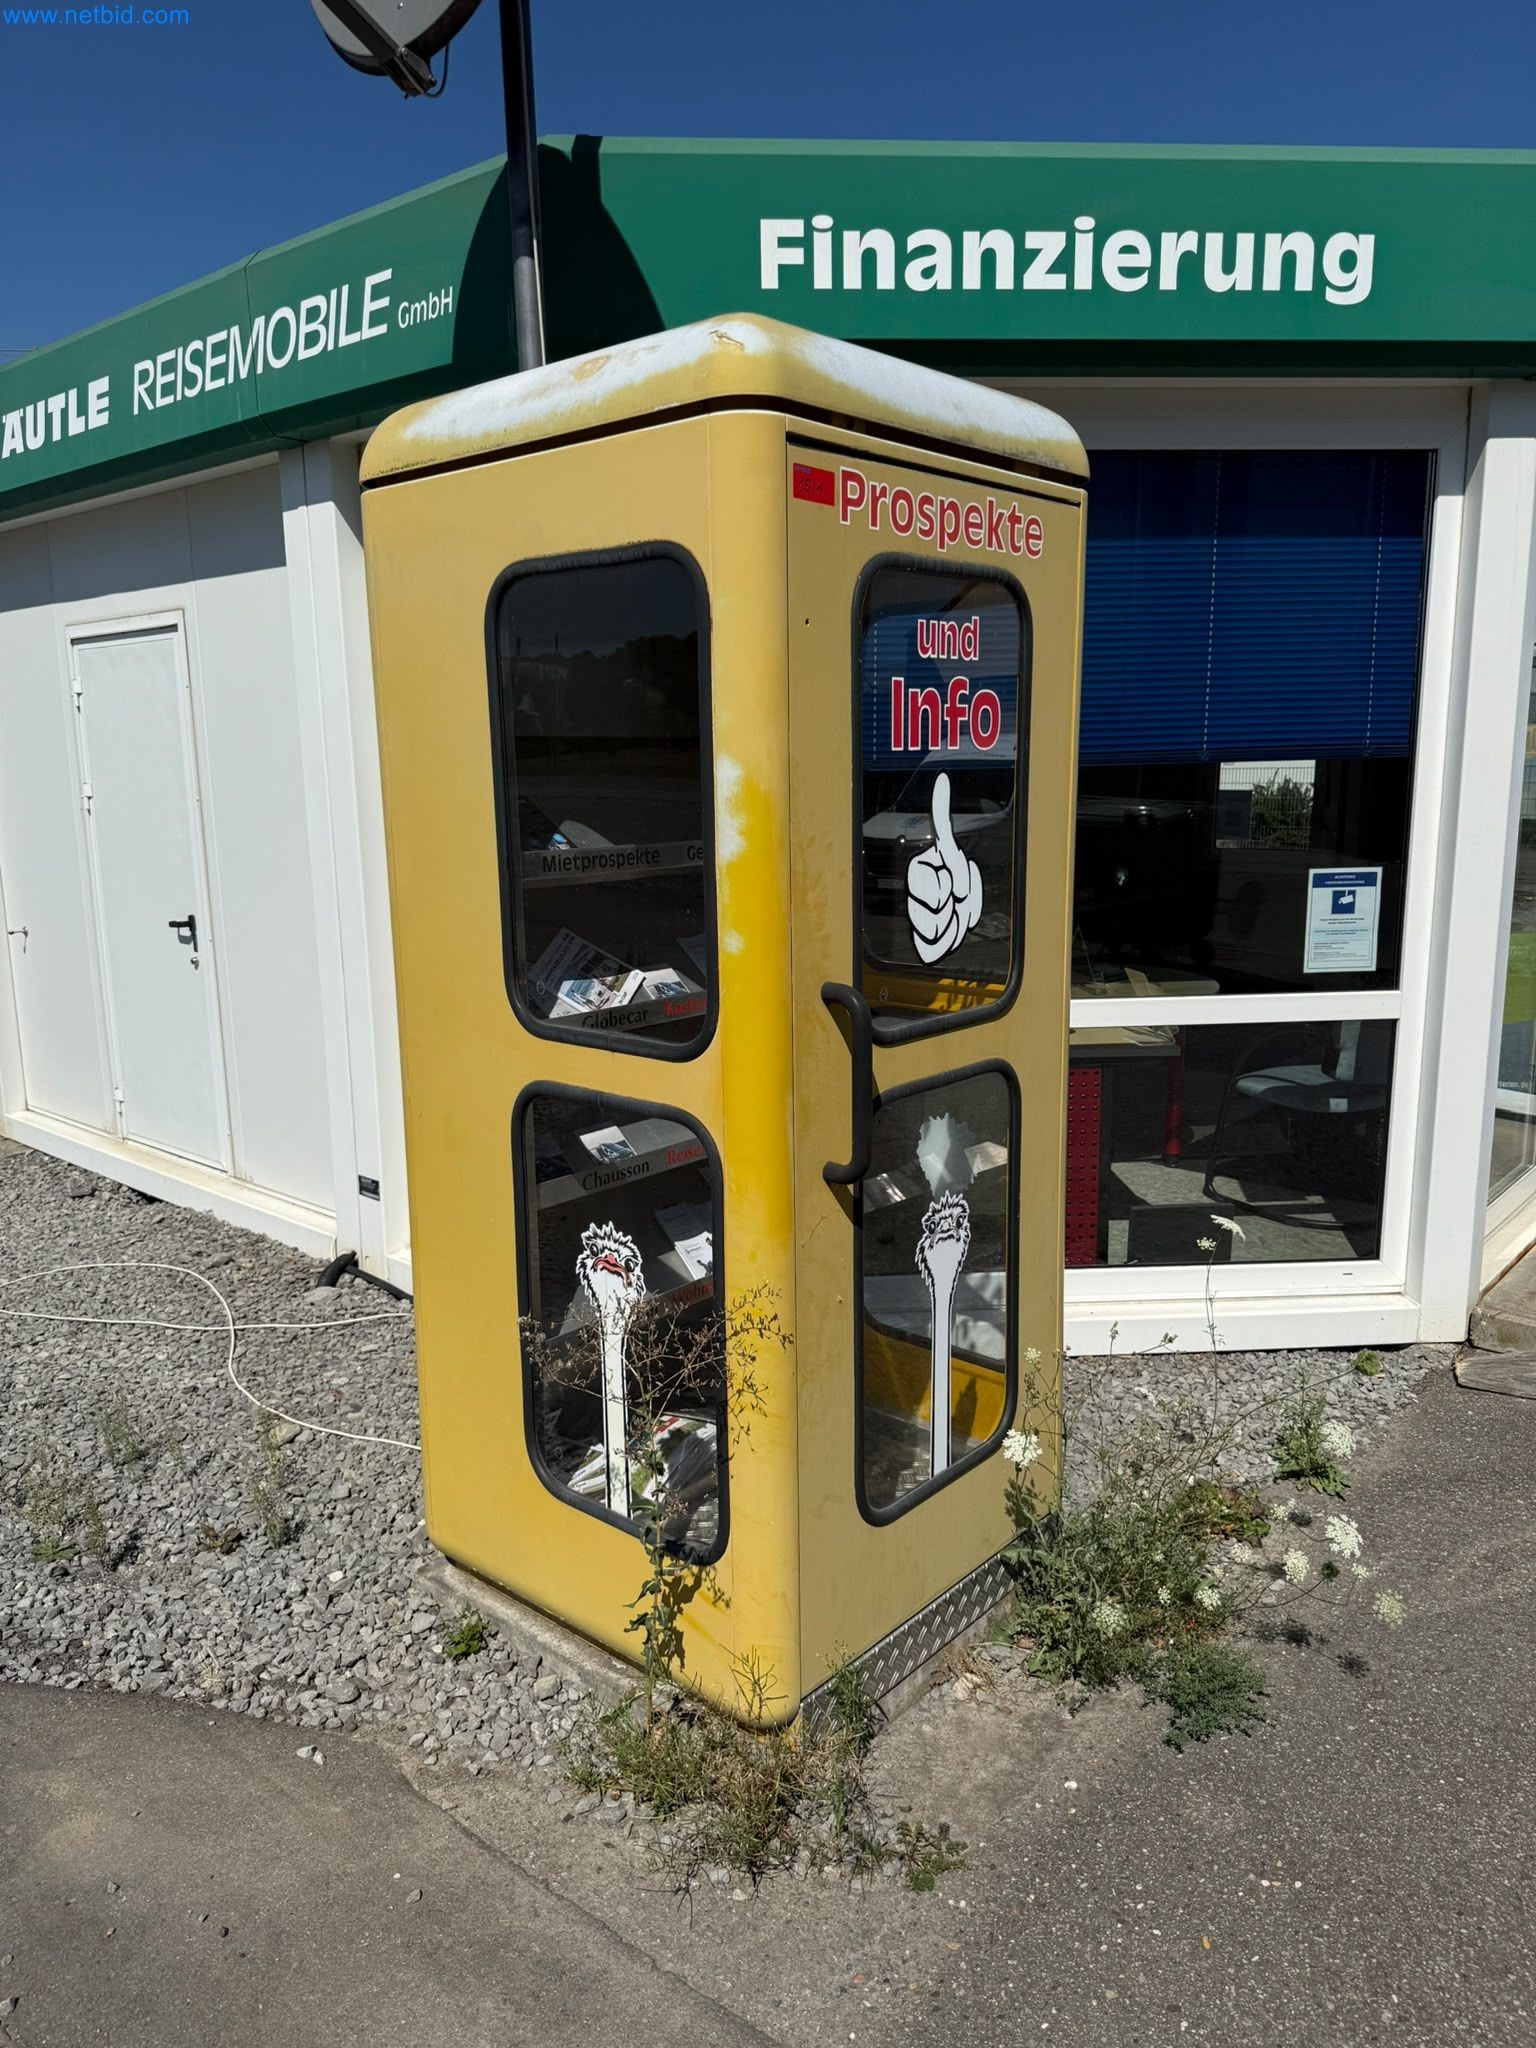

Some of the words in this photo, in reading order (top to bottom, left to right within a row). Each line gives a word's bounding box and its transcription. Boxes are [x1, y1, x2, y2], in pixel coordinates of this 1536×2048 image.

[759, 214, 1376, 306] Finanzierung
[1, 375, 110, 459] ÄUTLE
[133, 267, 393, 415] REISEMOBILE
[397, 286, 454, 329] GmbH
[839, 466, 1043, 559] Prospekte
[917, 616, 980, 662] und
[891, 676, 1001, 751] Info
[542, 848, 661, 873] Mietprospekte
[582, 1009, 649, 1030] Globecar
[582, 1161, 650, 1191] Chausson
